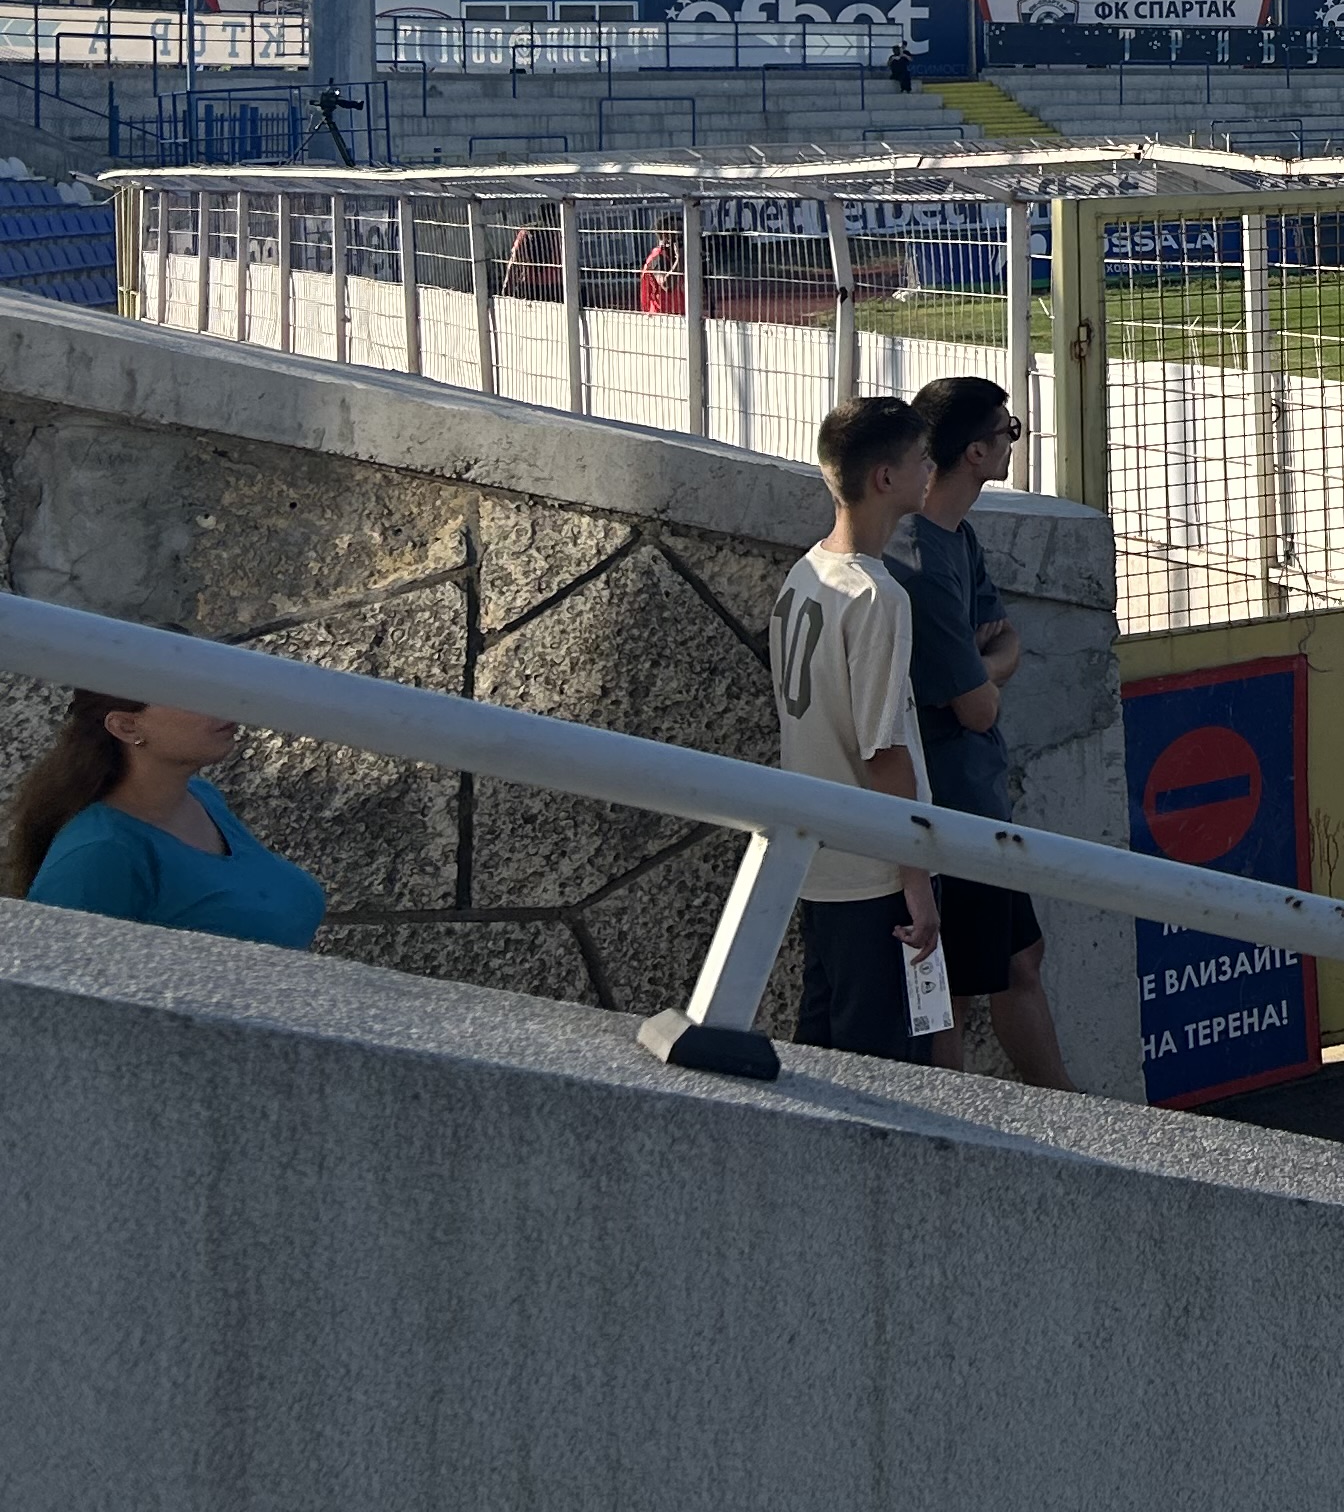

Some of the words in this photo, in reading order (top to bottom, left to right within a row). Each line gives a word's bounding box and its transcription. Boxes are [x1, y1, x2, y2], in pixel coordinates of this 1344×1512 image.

[1094, 1, 1129, 20] ФК
[1141, 0, 1237, 19] СПАРТАК
[1104, 229, 1217, 255] SSALA
[771, 588, 824, 720] 10
[1165, 946, 1299, 996] ВЛИЗАЙТЕ
[1184, 999, 1289, 1050] ТЕРЕНА!
